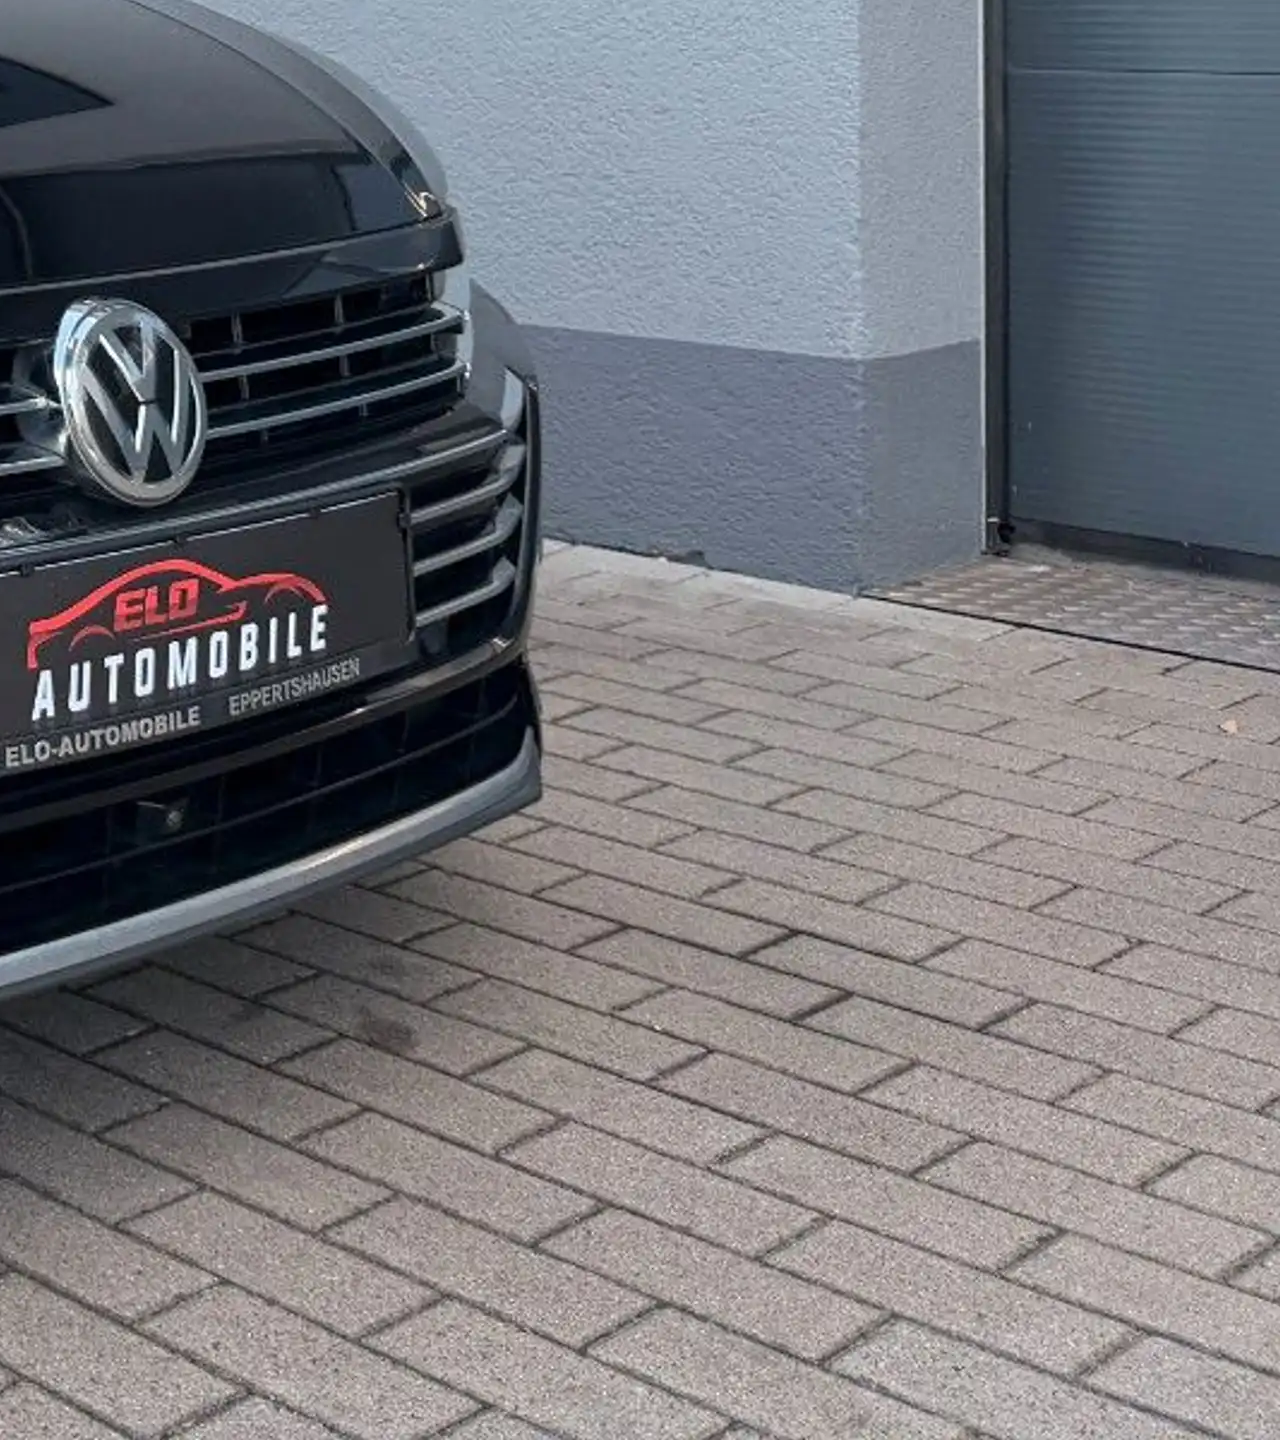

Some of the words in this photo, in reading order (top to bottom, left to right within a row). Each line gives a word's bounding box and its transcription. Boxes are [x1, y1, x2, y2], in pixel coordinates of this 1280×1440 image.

[114, 578, 200, 633] ELO
[4, 705, 201, 769] ELO-AUTOMOBILE
[228, 657, 361, 717] EPPERTSHAUSEN
[32, 604, 329, 721] AUTOMOBILE
